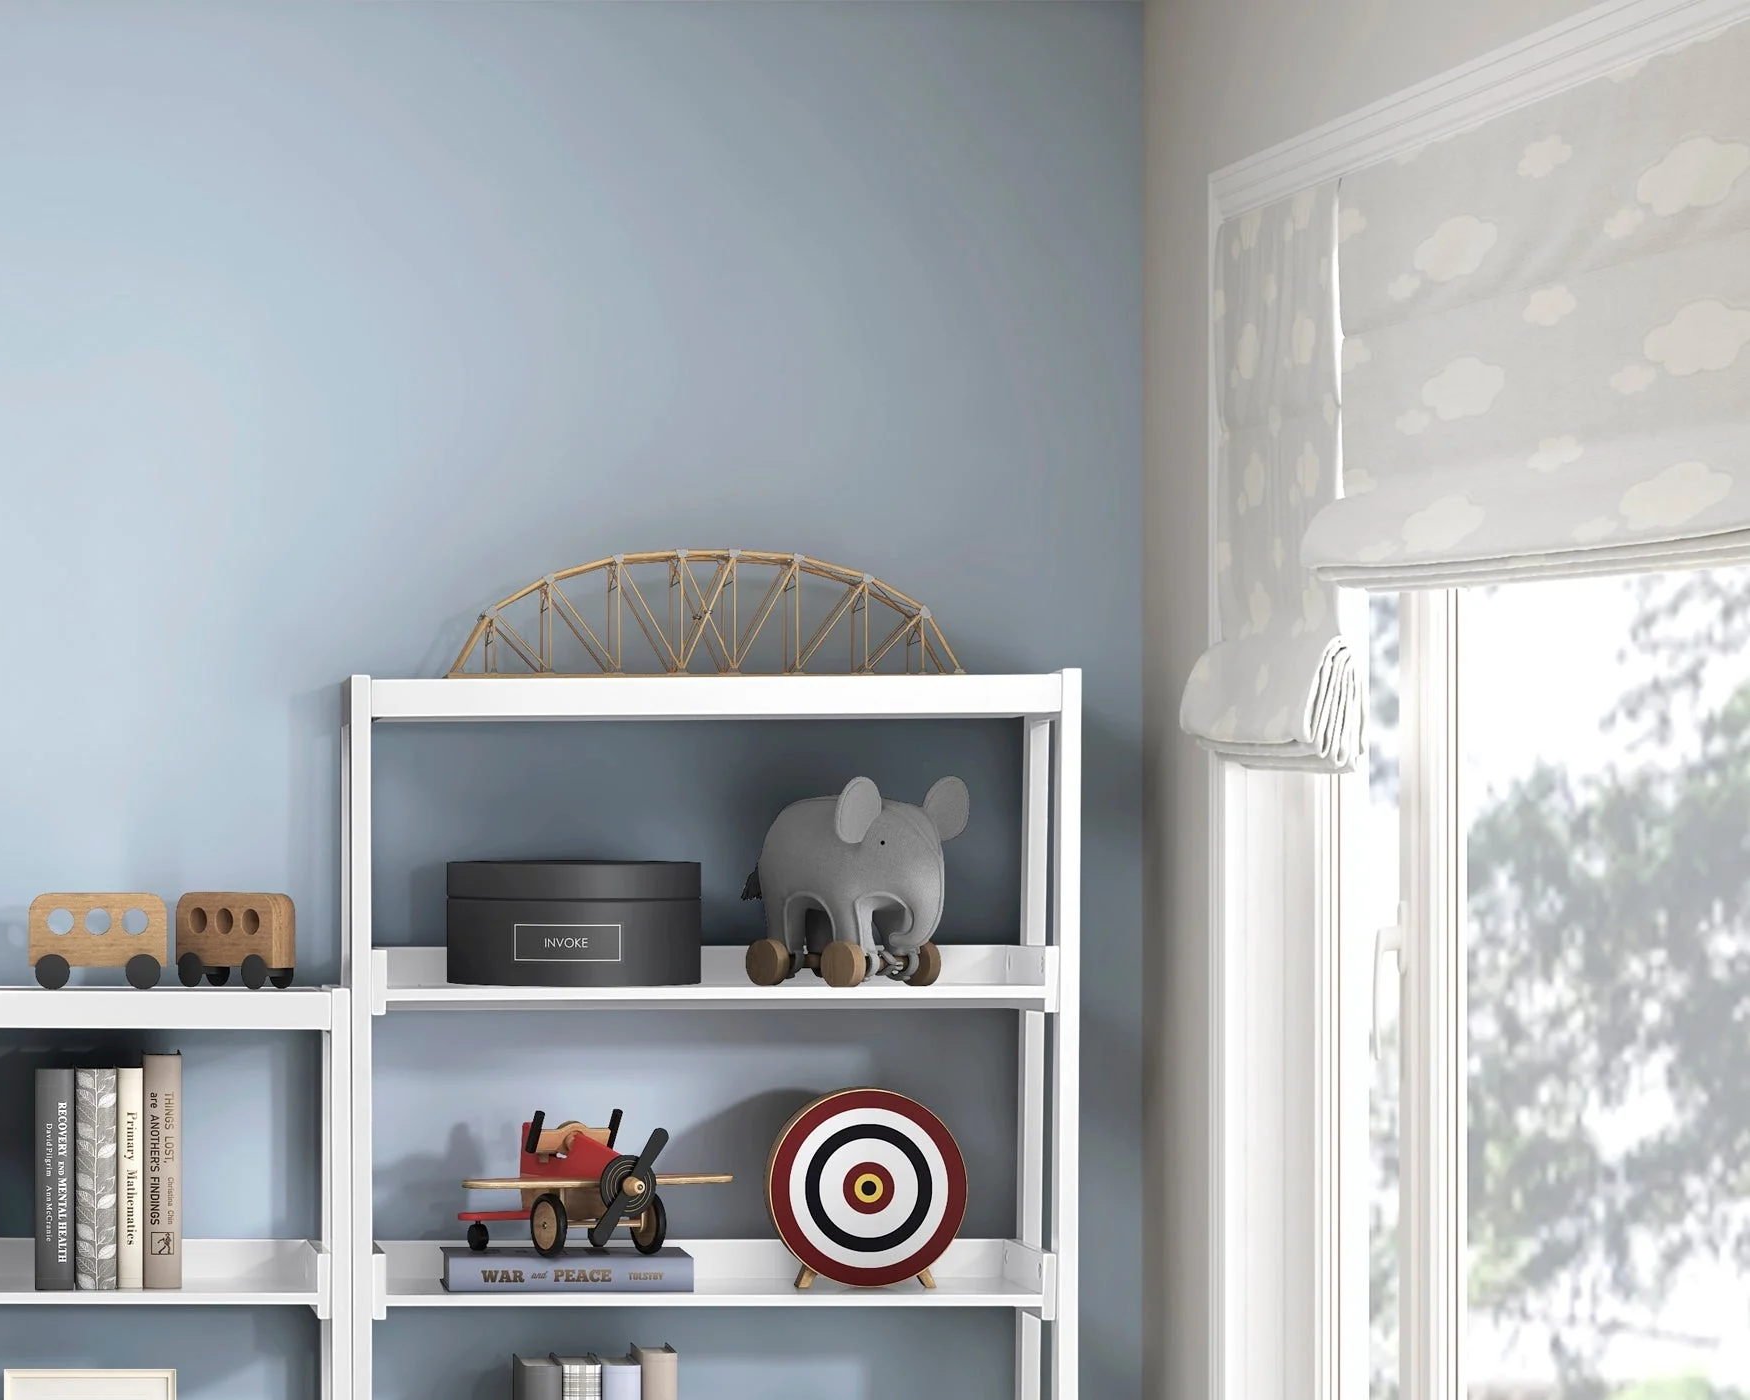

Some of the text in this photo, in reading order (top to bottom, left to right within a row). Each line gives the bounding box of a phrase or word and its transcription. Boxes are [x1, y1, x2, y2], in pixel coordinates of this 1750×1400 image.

[544, 937, 589, 949] INVOKE
[57, 1102, 68, 1156] RECOVERY
[163, 1092, 175, 1164] THINGS LOST,
[44, 1147, 53, 1177] Pilgrim
[124, 1112, 138, 1246] Primary Mathematics
[149, 1092, 160, 1226] are ANOTHER'S FINDINGS
[57, 1177, 68, 1220] MENTAL
[167, 1177, 175, 1225] Christina Chin
[57, 1222, 68, 1263] HEALTH
[481, 1269, 612, 1283] WAR and PEACE
